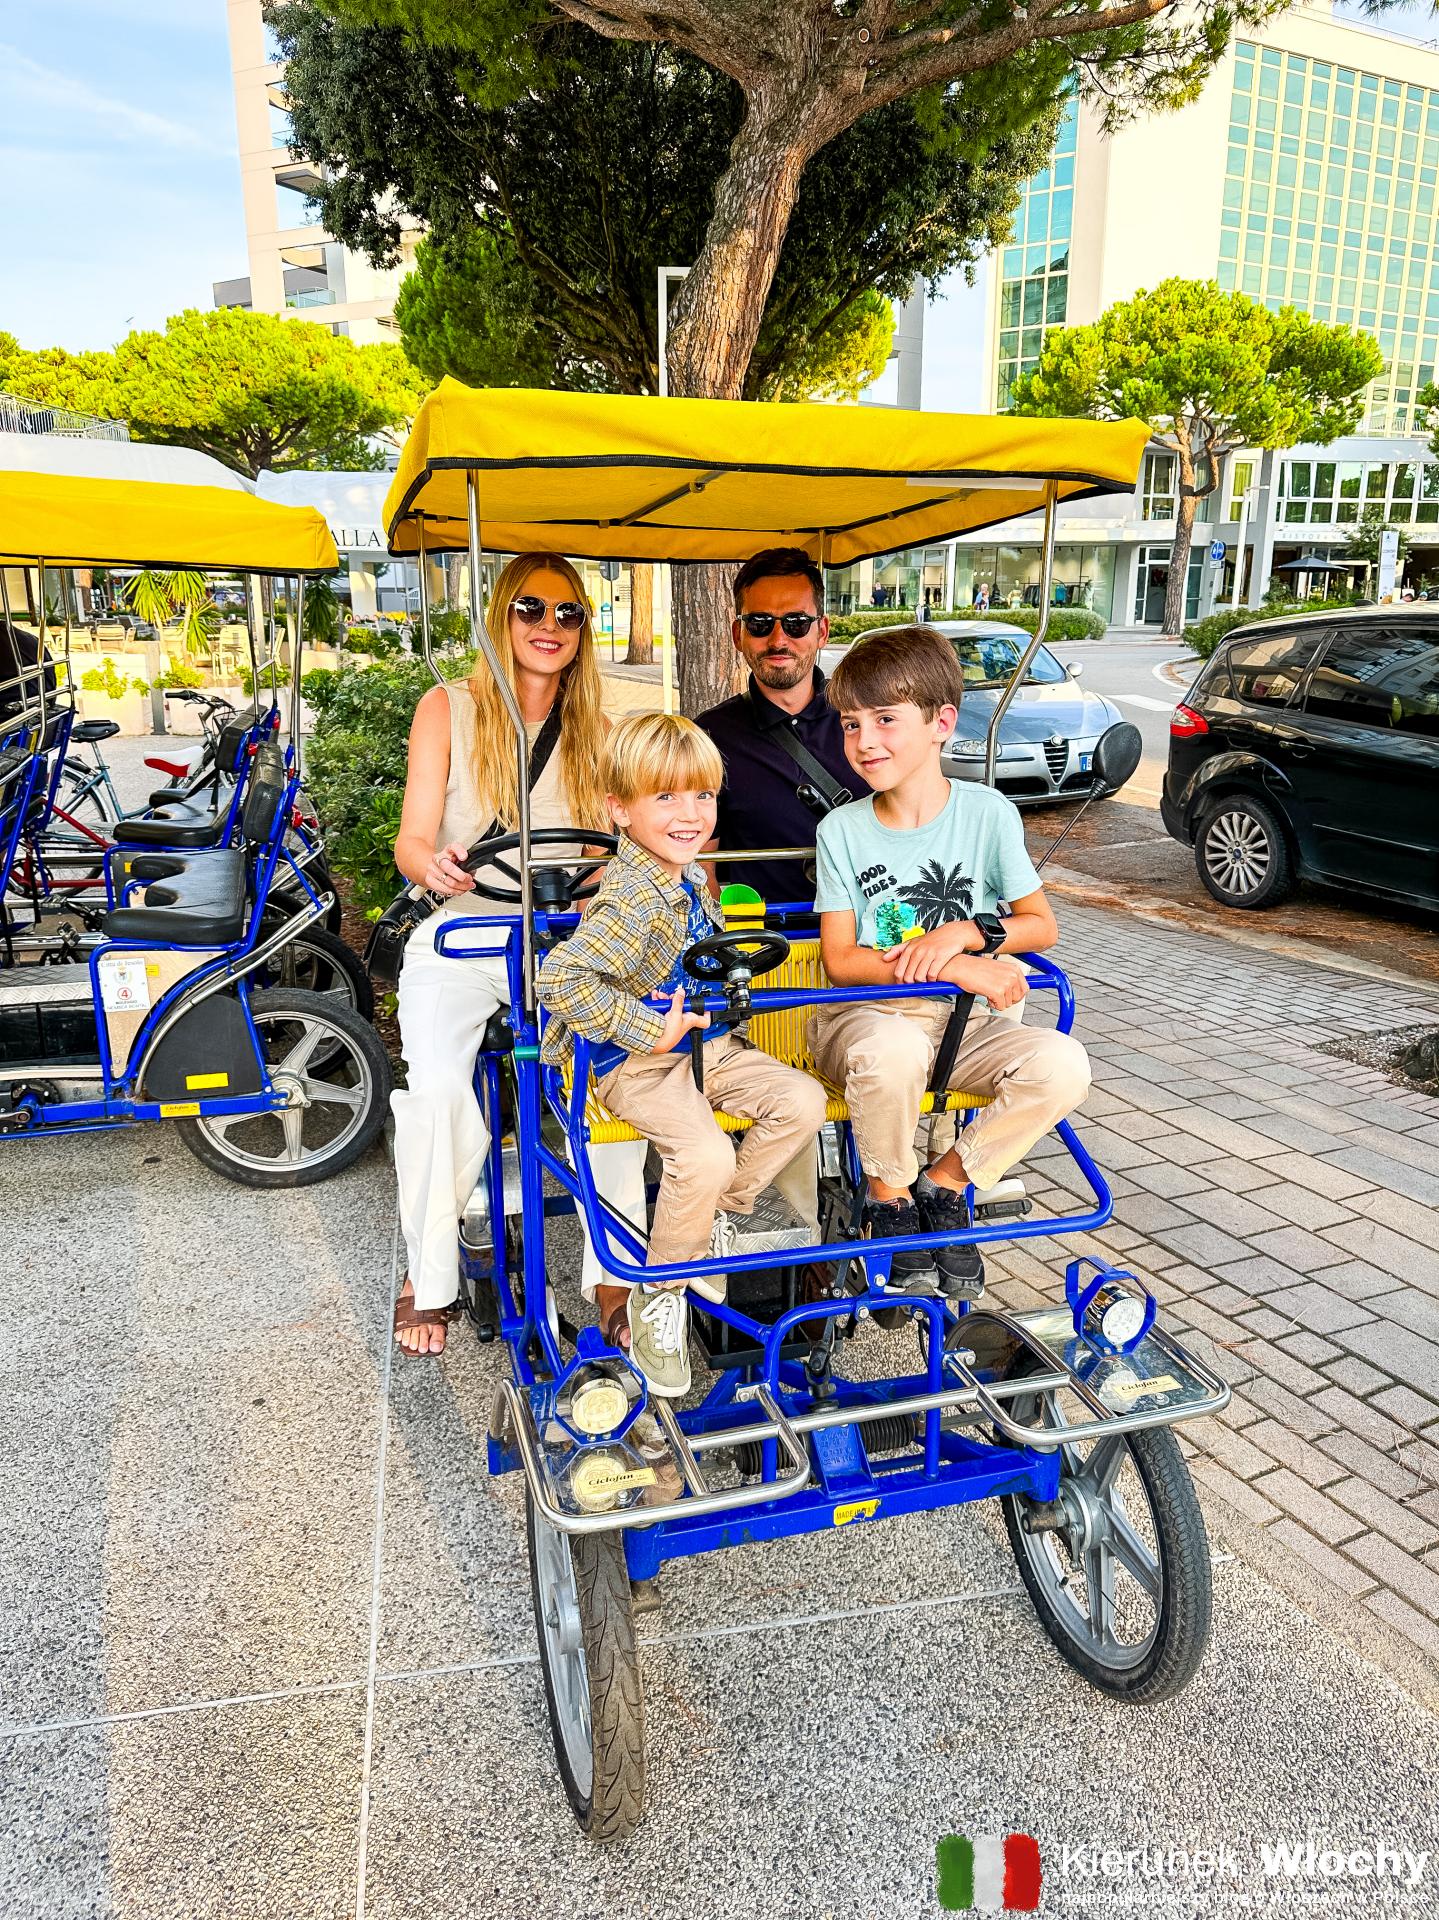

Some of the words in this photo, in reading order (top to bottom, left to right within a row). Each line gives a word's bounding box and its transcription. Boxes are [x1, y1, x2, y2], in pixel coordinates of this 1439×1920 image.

[121, 989, 129, 998] 4
[588, 1474, 634, 1486] Ciclofan
[836, 1509, 854, 1520] MADE
